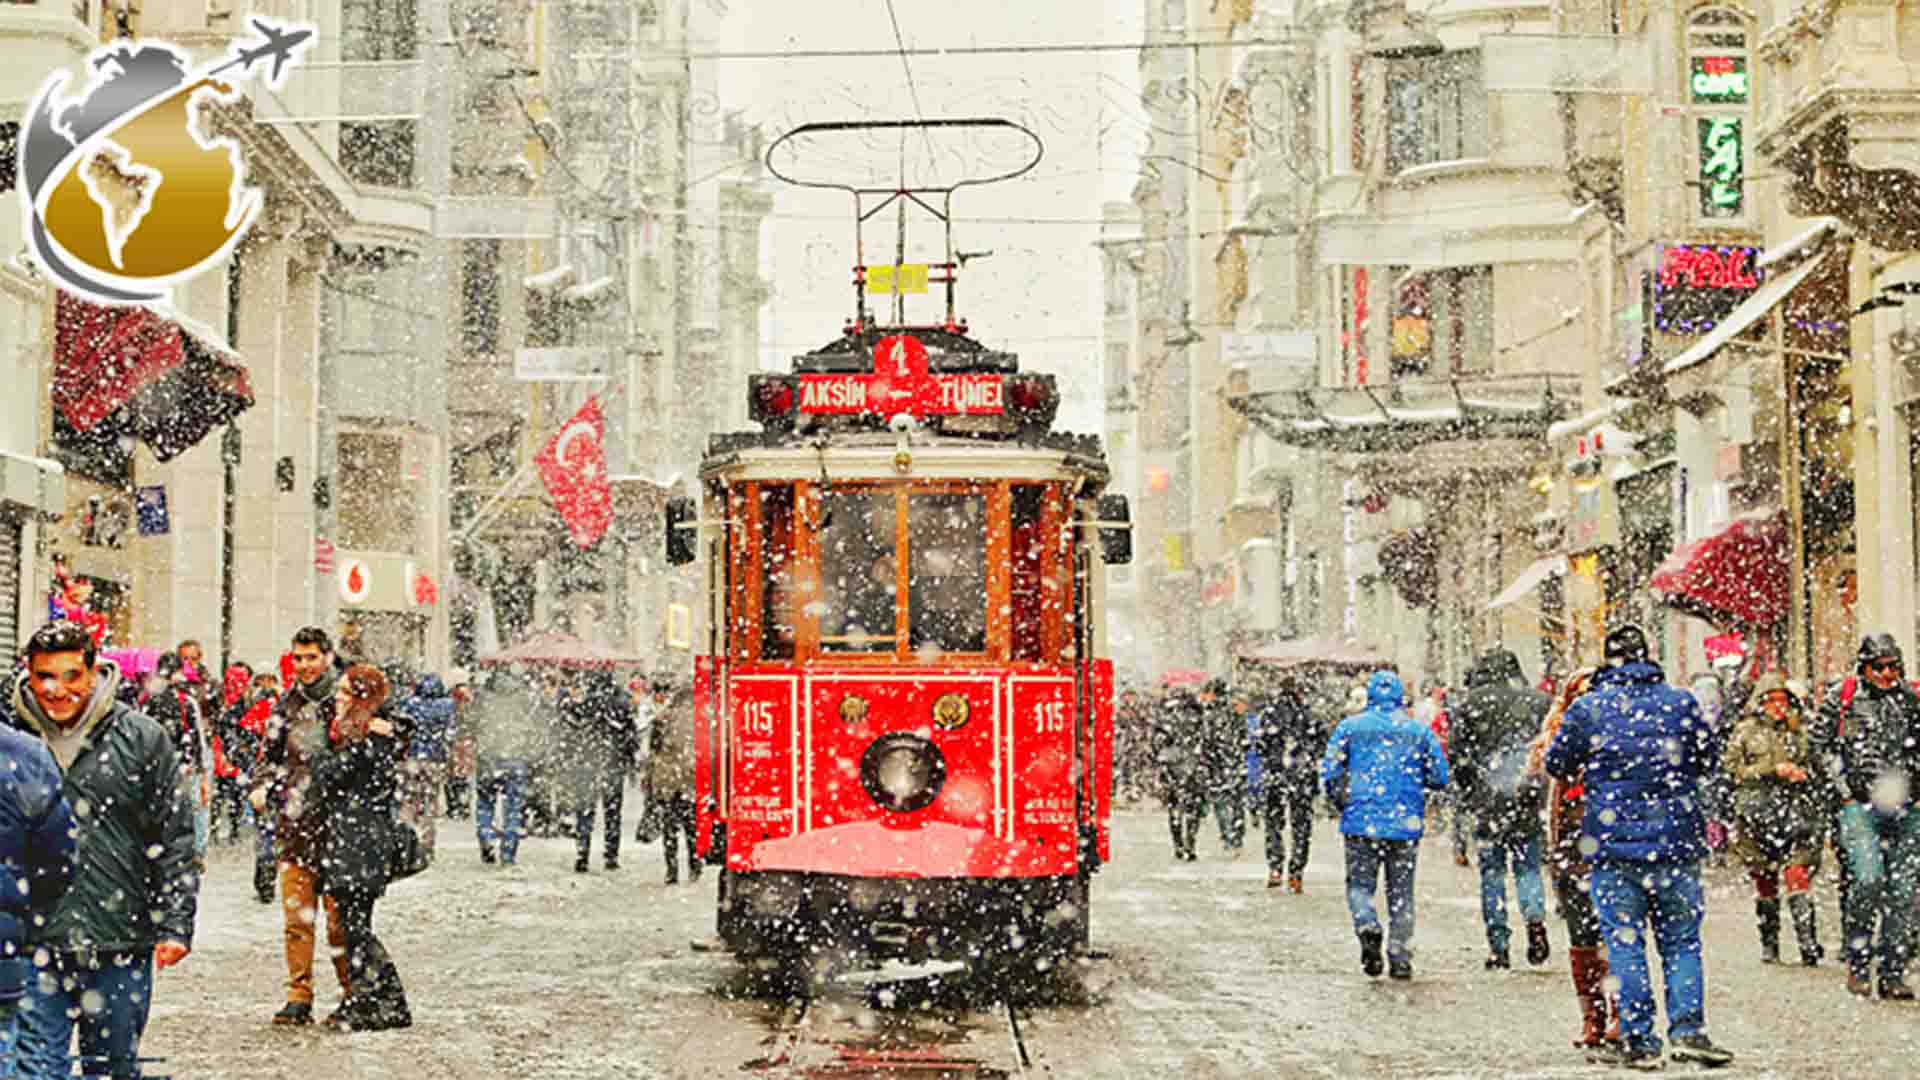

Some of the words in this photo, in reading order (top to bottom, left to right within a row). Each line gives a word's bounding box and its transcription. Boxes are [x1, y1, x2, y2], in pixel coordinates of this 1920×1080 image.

[889, 341, 910, 376] 1
[799, 377, 866, 407] AKSİM
[744, 702, 774, 732] 115
[1034, 702, 1064, 732] 115
